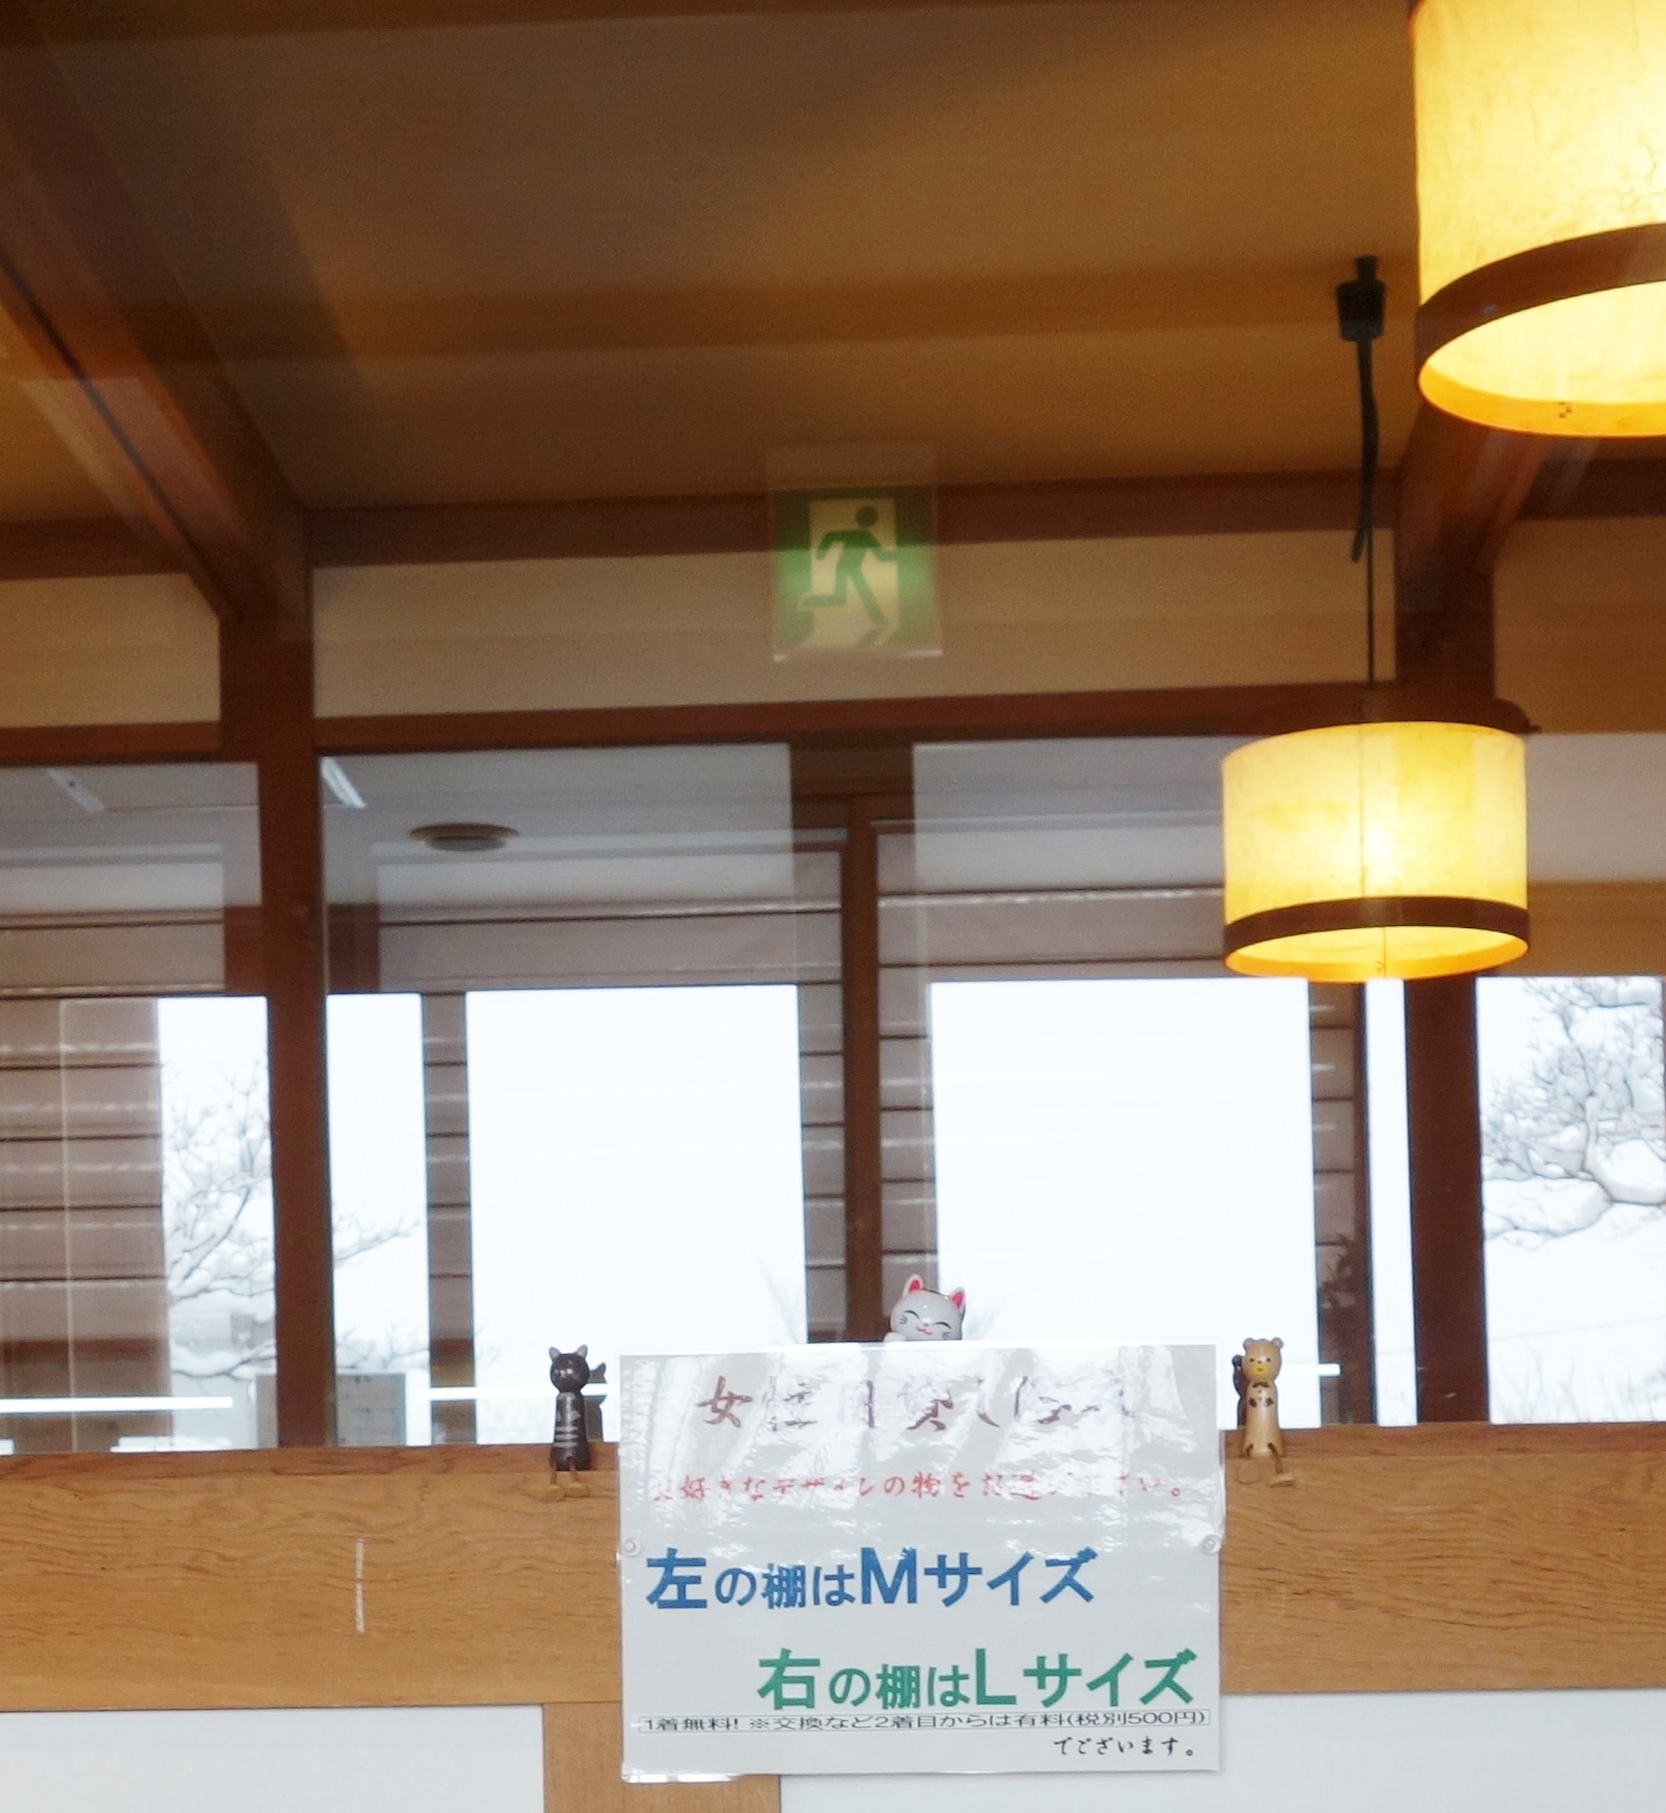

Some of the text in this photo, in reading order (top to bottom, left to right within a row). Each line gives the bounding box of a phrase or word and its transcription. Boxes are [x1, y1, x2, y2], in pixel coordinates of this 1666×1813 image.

[646, 1547, 1098, 1610] 左の棚はMサイズ
[758, 1647, 1196, 1710] 右の棚はLサイズ
[1054, 1736, 1195, 1757] でございます。
